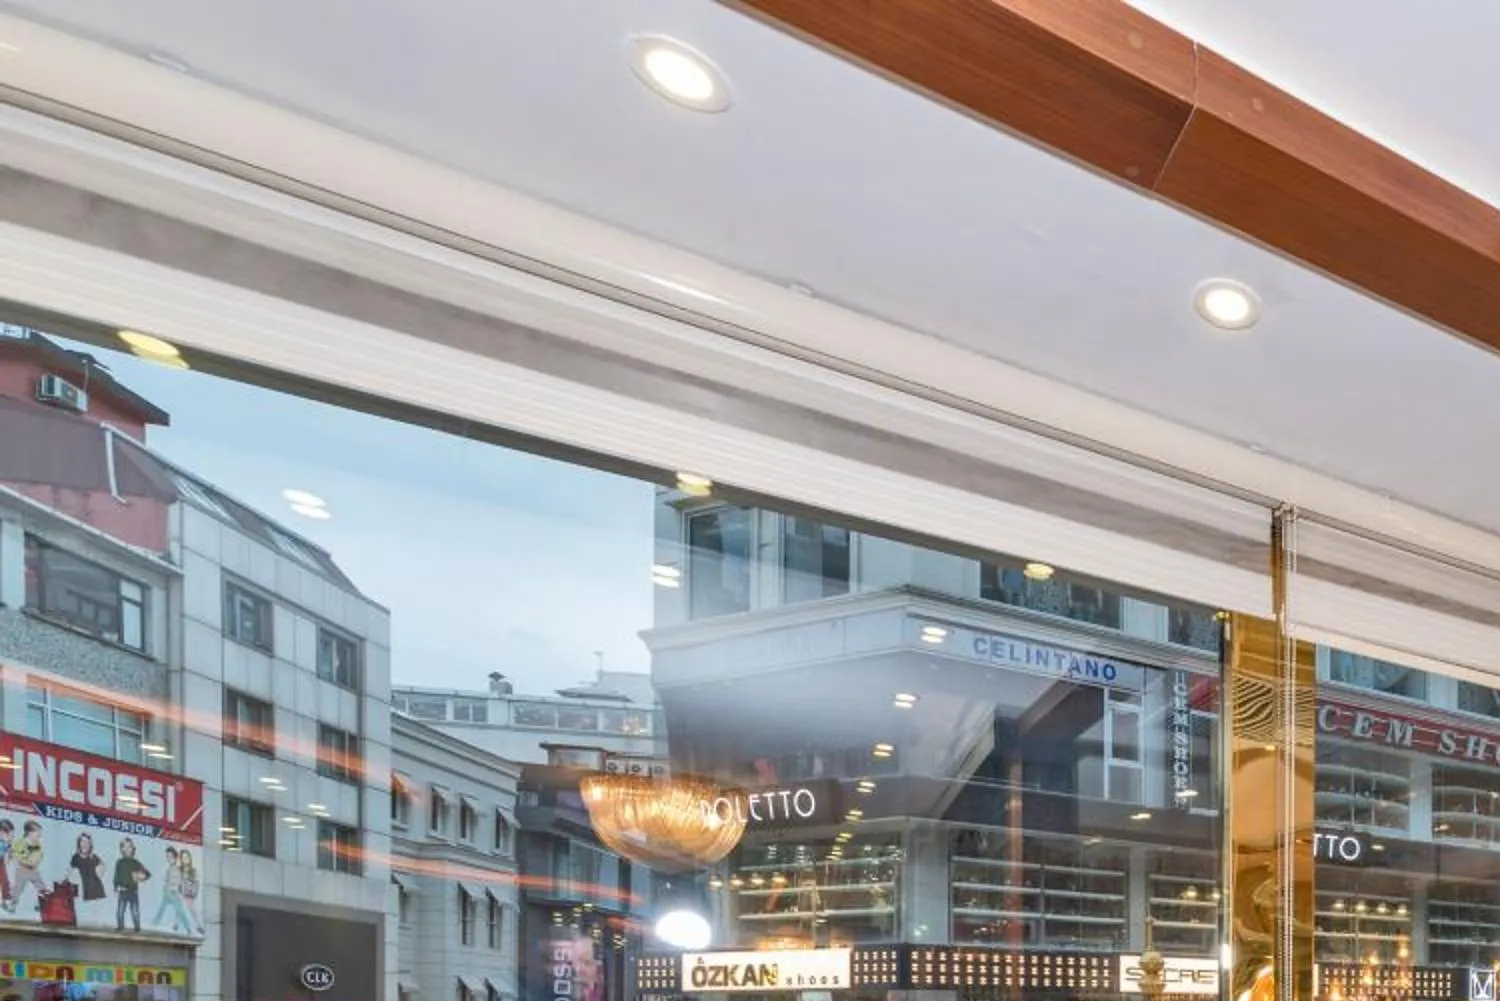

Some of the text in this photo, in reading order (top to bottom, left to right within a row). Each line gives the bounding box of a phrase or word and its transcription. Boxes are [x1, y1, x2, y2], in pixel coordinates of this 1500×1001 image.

[973, 637, 1117, 681] CELINTANO
[1318, 703, 1417, 748] CEM
[47, 805, 83, 824] KIDS
[103, 817, 155, 837] JUNIOR
[306, 971, 330, 984] CLK
